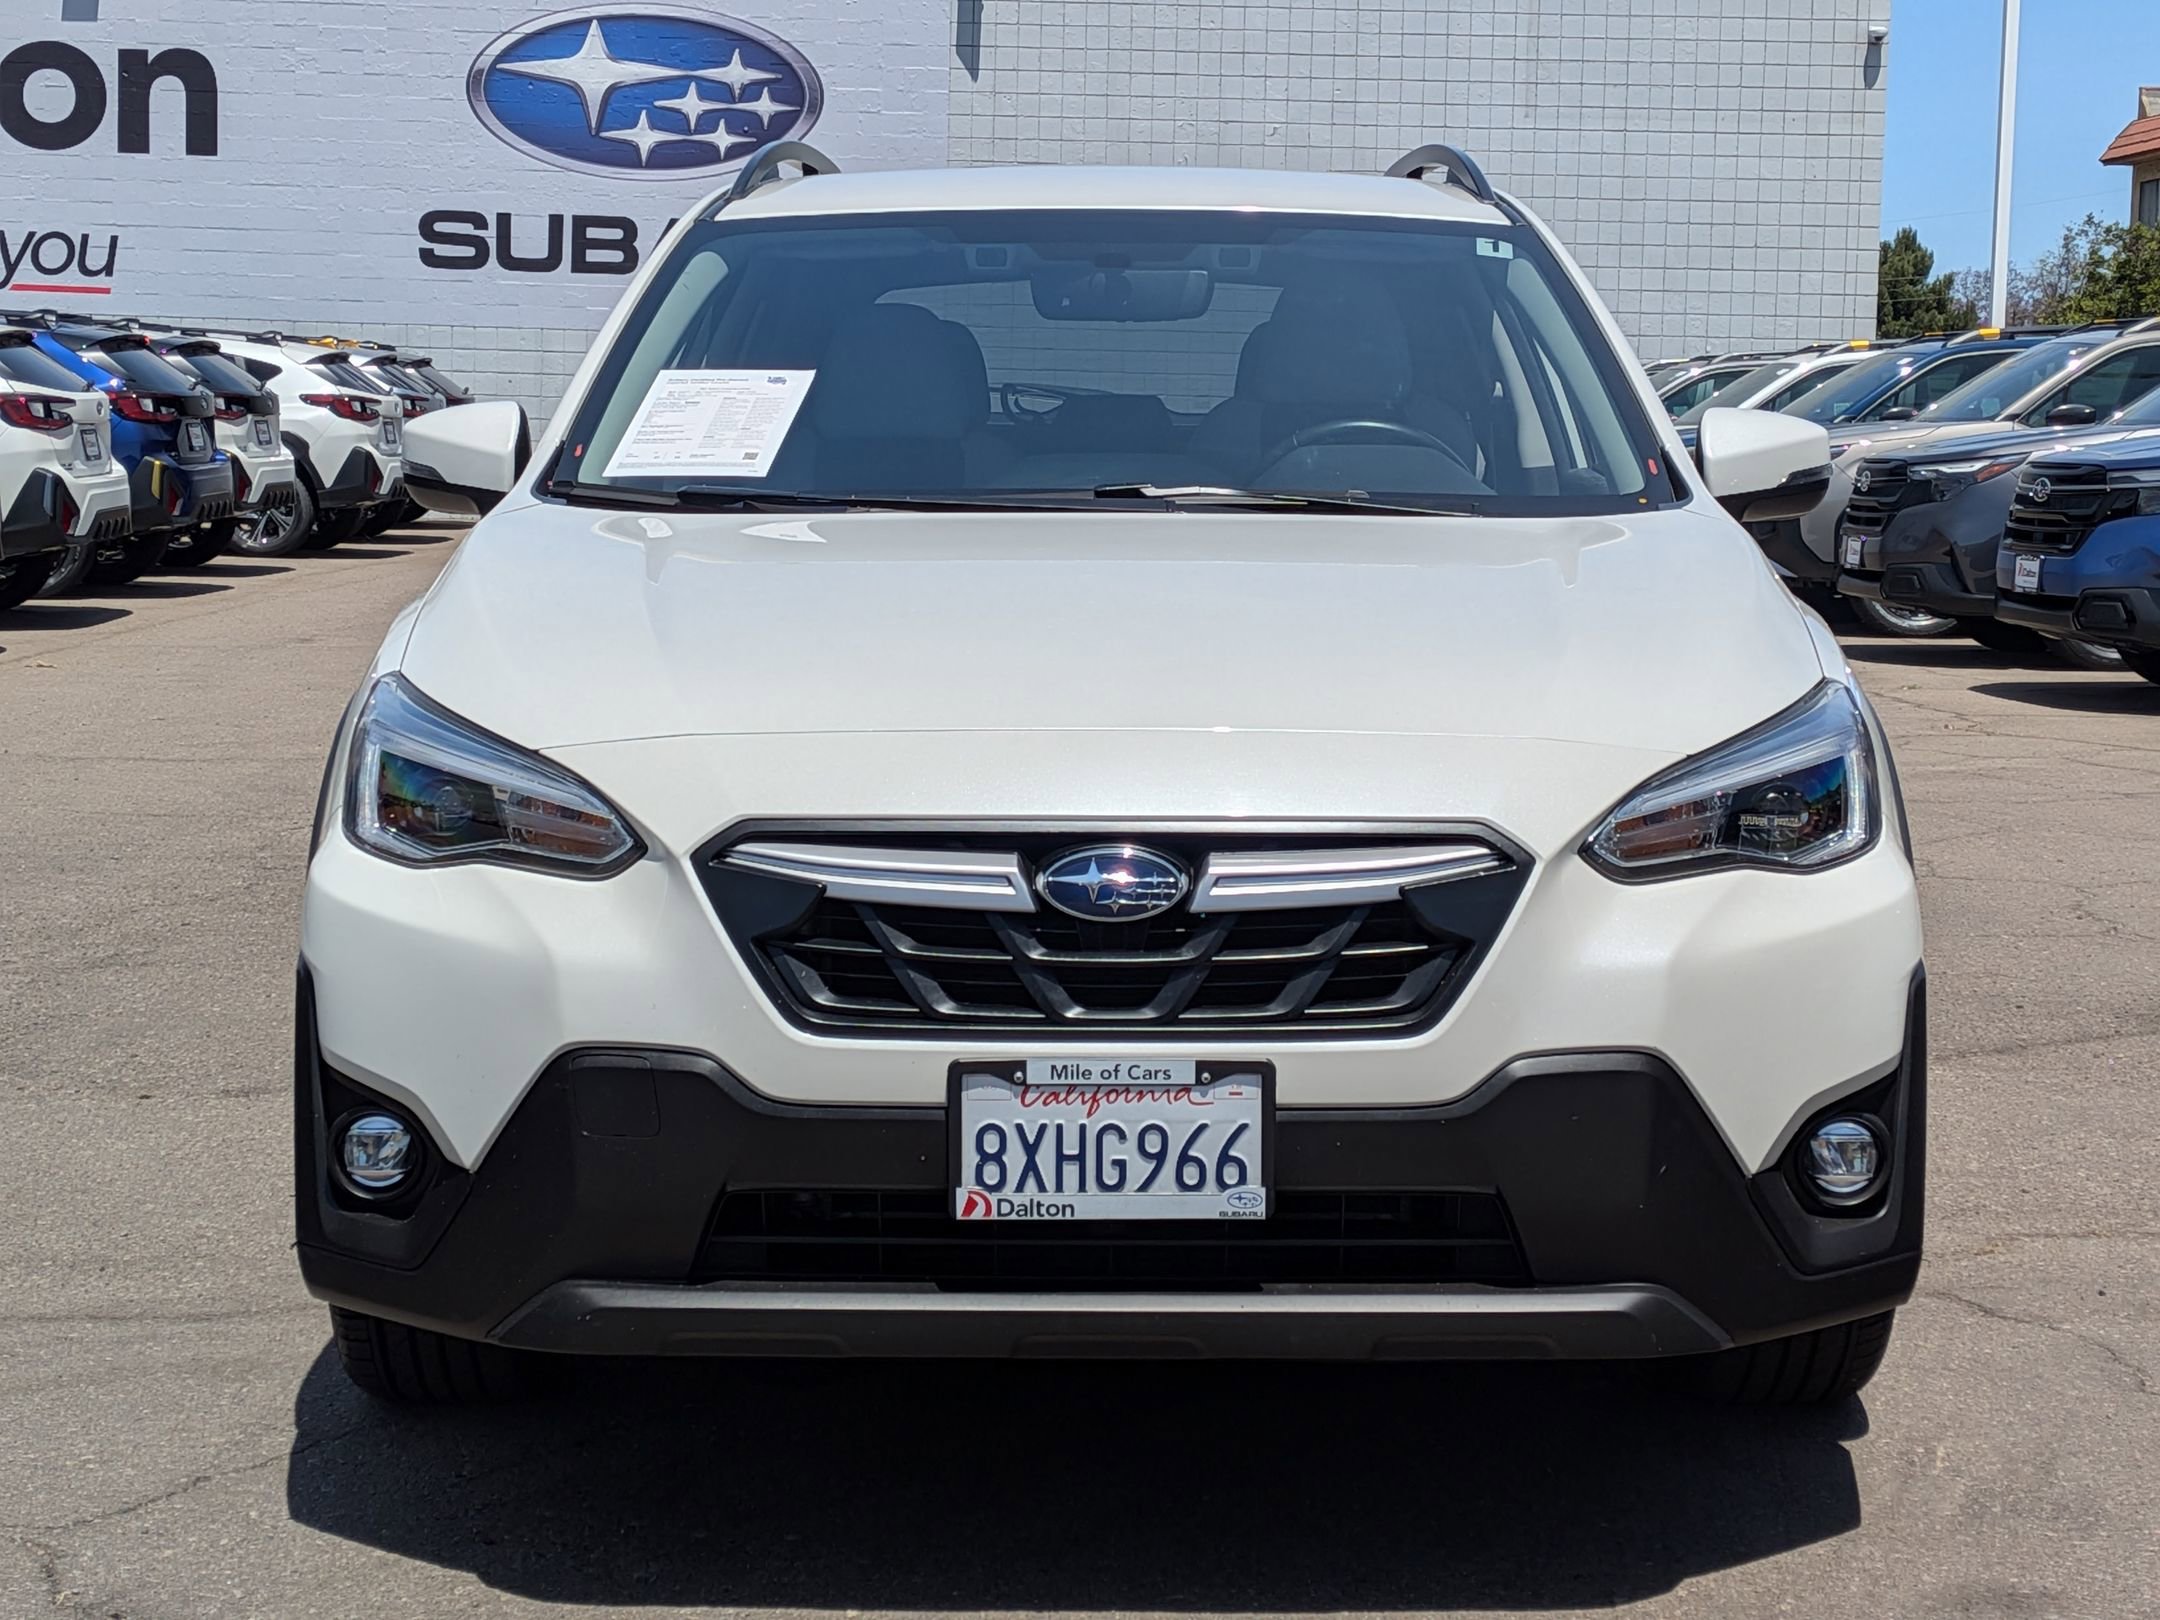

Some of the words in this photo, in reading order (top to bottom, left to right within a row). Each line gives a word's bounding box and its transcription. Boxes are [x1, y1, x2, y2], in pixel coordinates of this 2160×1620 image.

[0, 229, 119, 290] you
[1050, 1063, 1093, 1080] Mile
[1100, 1063, 1122, 1080] of
[1127, 1064, 1172, 1081] Cars
[1020, 1084, 1215, 1119] California
[975, 1122, 1250, 1194] 8XHG966
[996, 1198, 1075, 1218] Dalton
